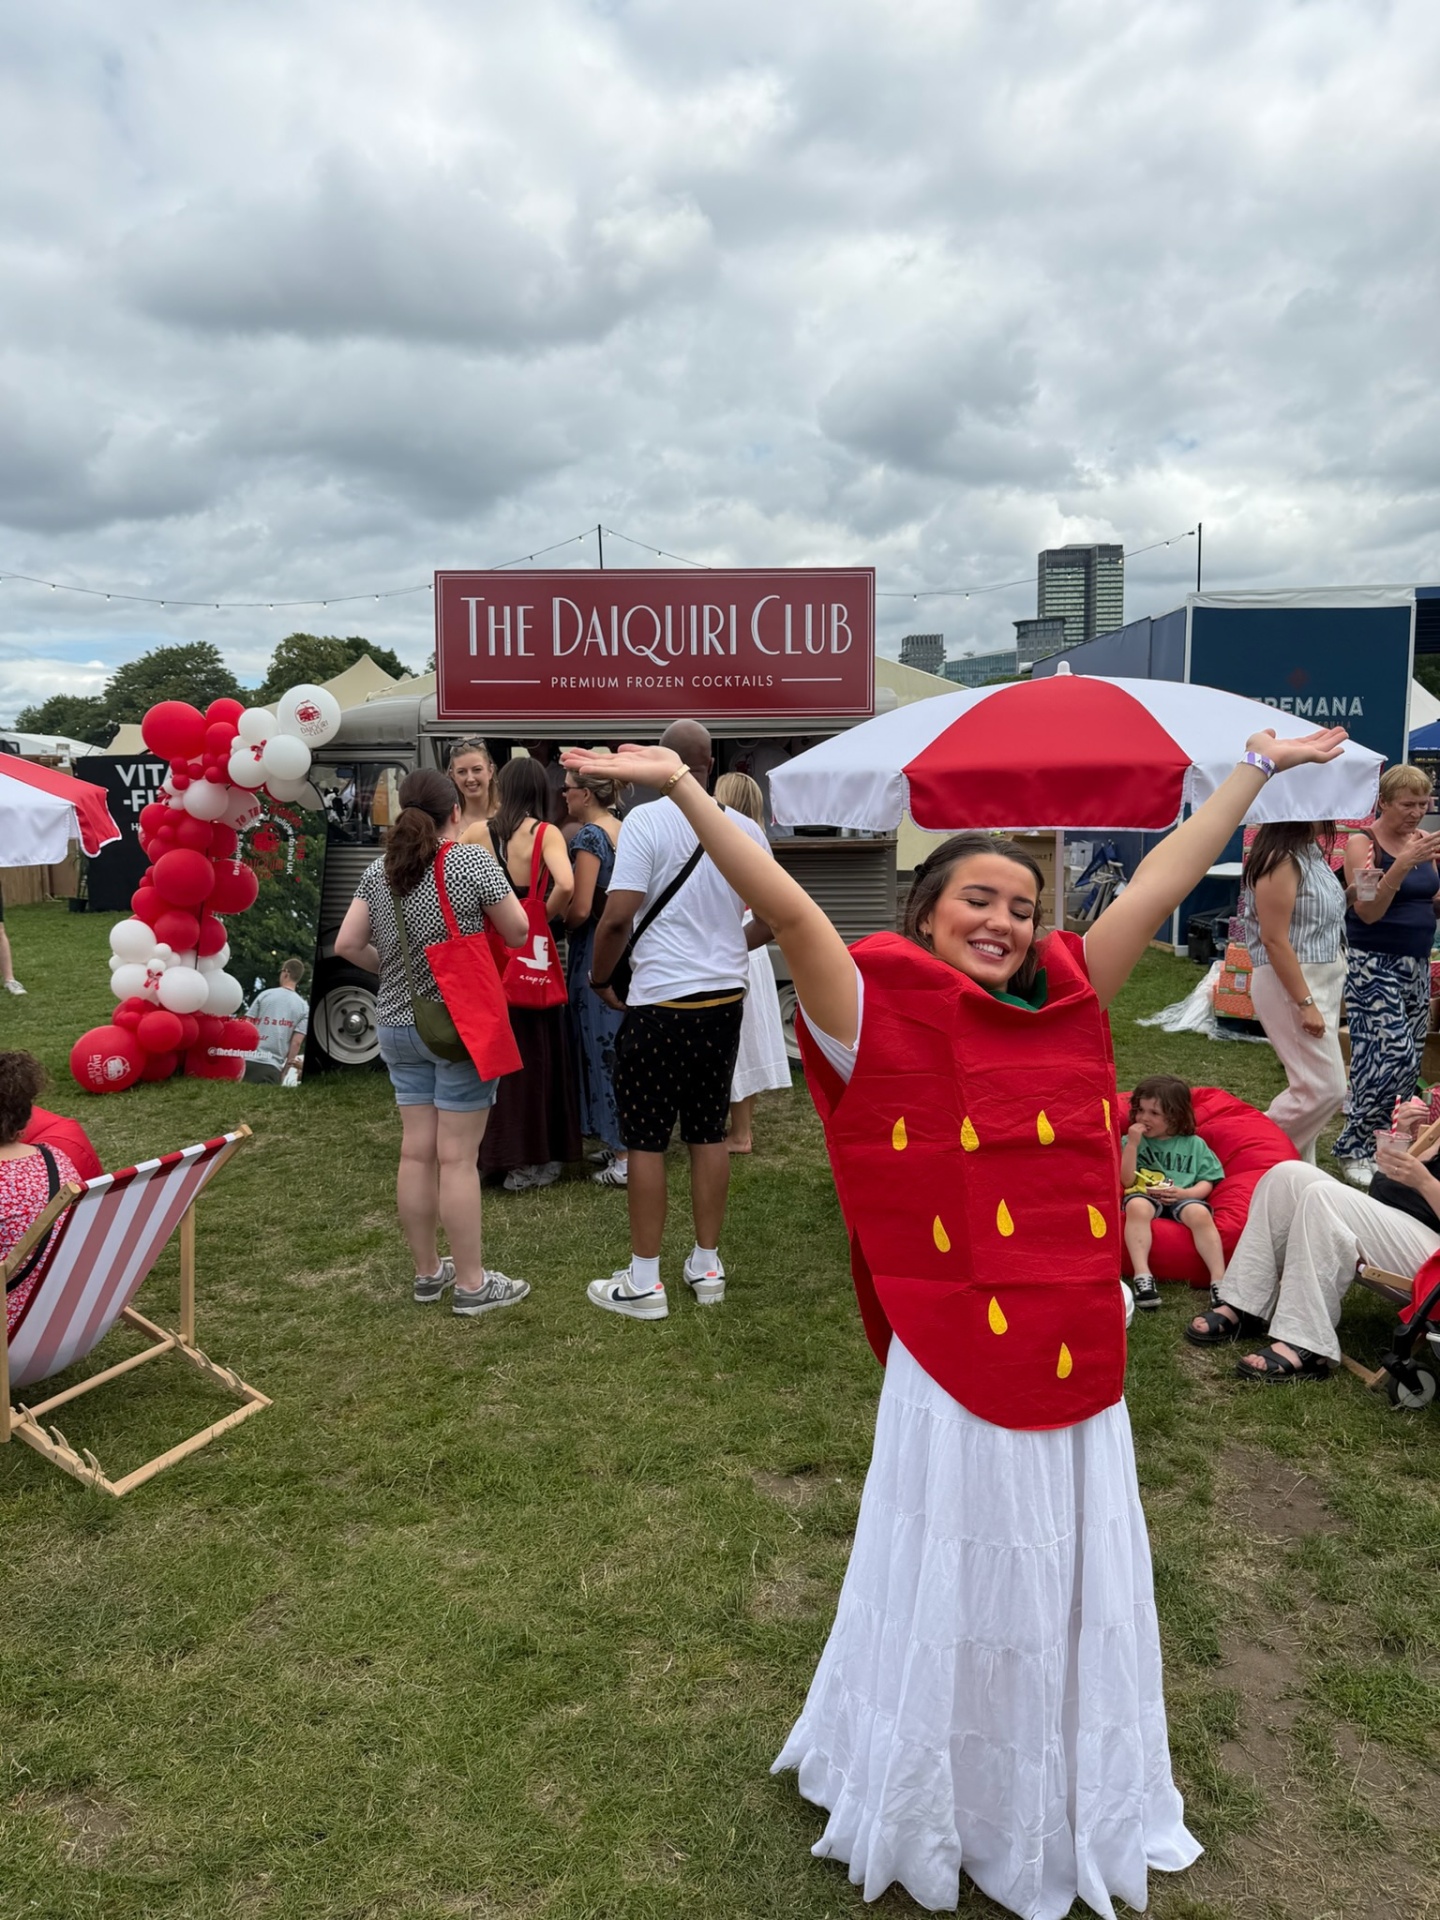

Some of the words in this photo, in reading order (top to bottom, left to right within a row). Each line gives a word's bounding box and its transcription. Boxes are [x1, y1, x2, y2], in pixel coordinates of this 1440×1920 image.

[461, 597, 535, 657] THE
[552, 596, 738, 667] DAIQUIRI
[750, 595, 853, 656] CLUB
[551, 676, 620, 689] PREMIUM
[626, 675, 685, 689] FROZEN
[692, 674, 775, 688] COCKTAILS
[286, 862, 294, 875] UK
